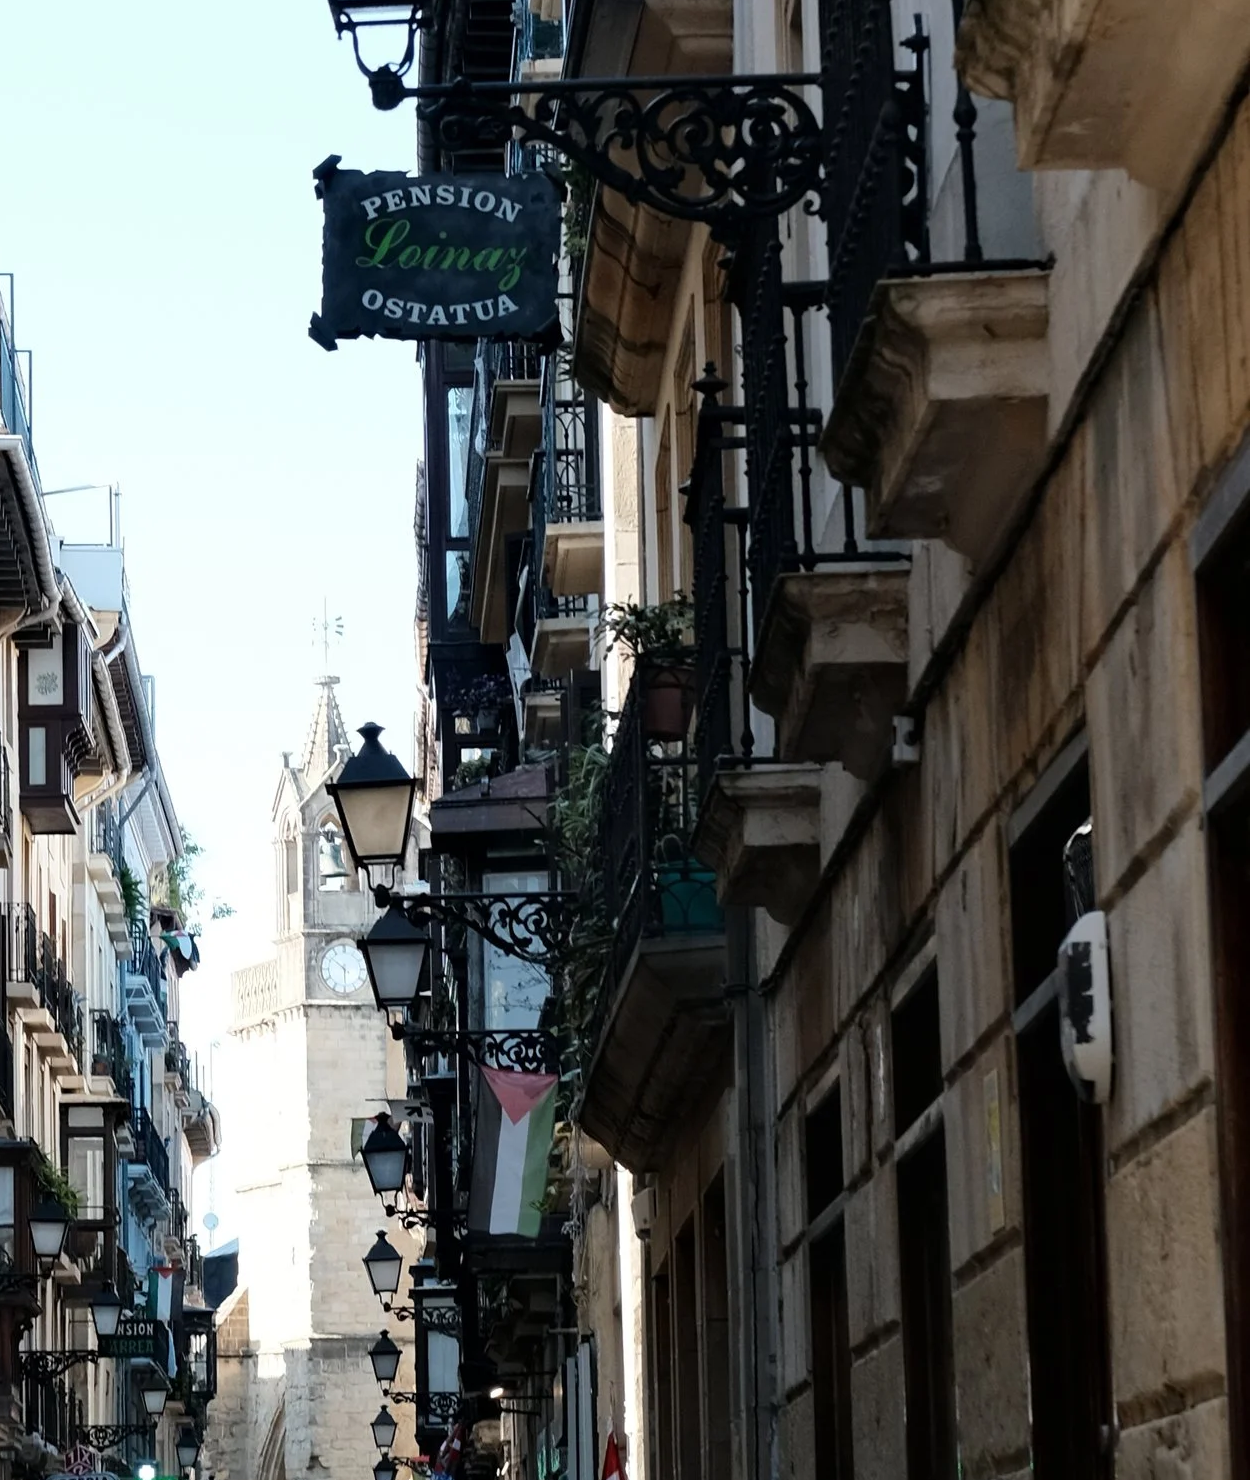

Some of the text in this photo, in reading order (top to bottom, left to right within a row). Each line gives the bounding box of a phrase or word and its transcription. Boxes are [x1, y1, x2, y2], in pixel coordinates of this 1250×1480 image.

[361, 184, 523, 223] PENSION
[355, 218, 527, 291] Loinaz
[361, 288, 519, 326] OSTATUA
[117, 1322, 154, 1336] NSION
